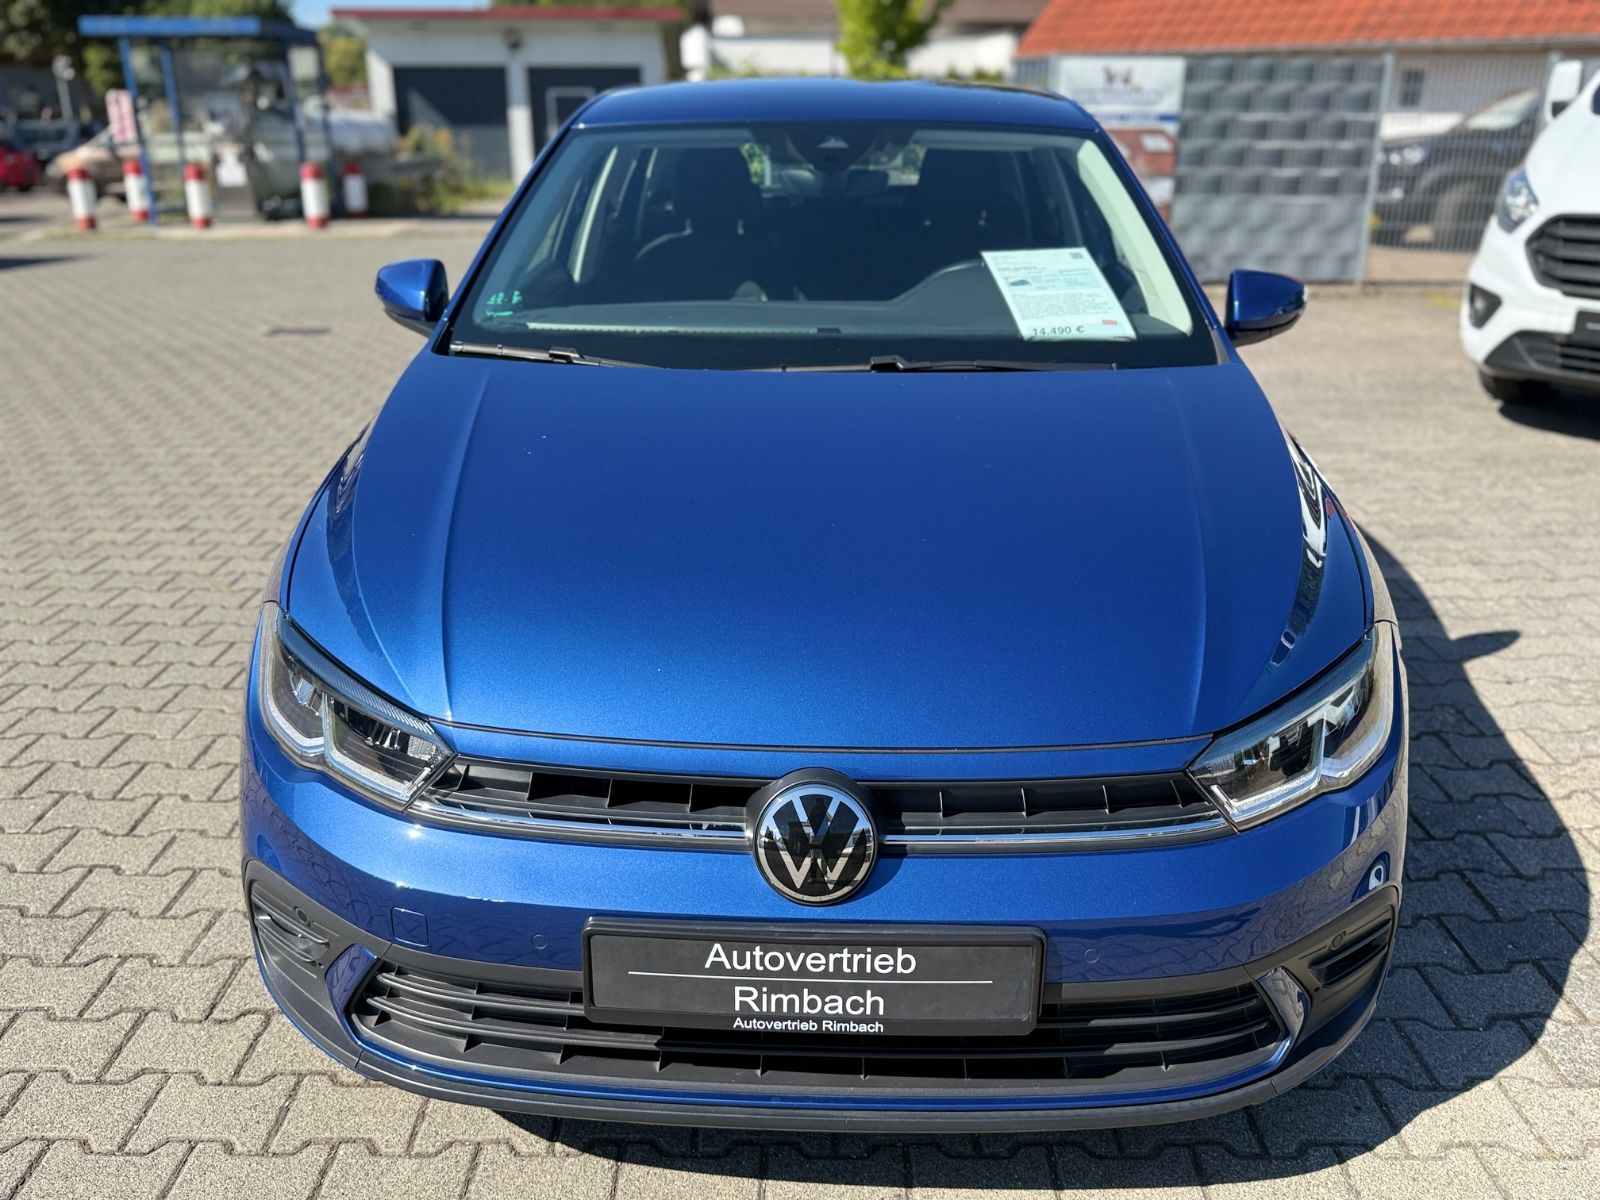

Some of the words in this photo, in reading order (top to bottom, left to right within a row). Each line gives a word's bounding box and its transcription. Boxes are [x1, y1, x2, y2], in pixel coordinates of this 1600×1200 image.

[1033, 326, 1072, 336] 14.490
[1076, 325, 1085, 334] €
[704, 943, 917, 975] Autovertrieb
[734, 985, 885, 1016] Rimbach
[733, 1017, 818, 1031] Autovertrieb
[822, 1020, 884, 1033] Rimbach
